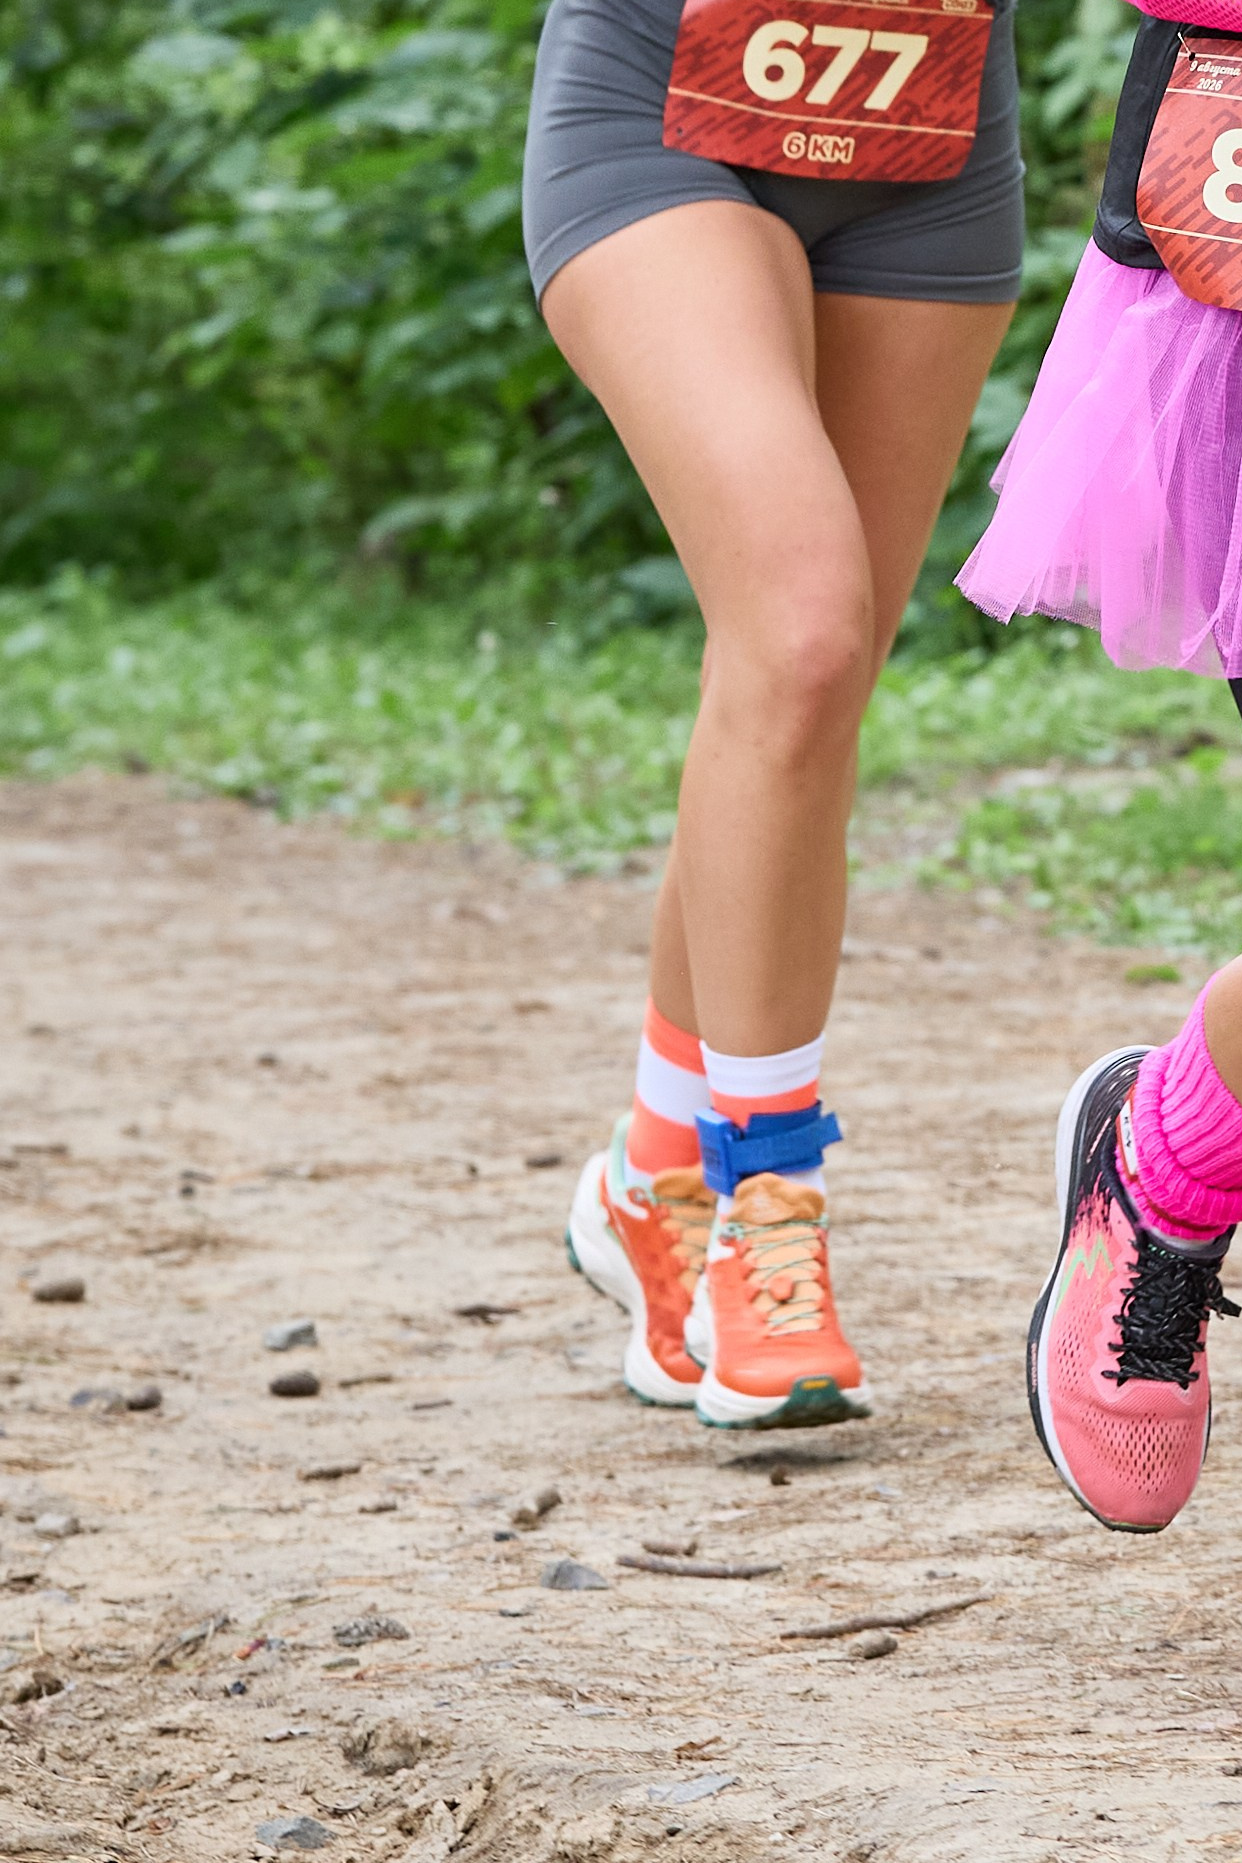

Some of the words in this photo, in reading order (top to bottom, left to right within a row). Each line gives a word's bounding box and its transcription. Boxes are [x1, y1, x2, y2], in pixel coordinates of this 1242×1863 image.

[743, 20, 929, 111] 677
[1197, 78, 1223, 92] 2026
[782, 131, 806, 159] 6
